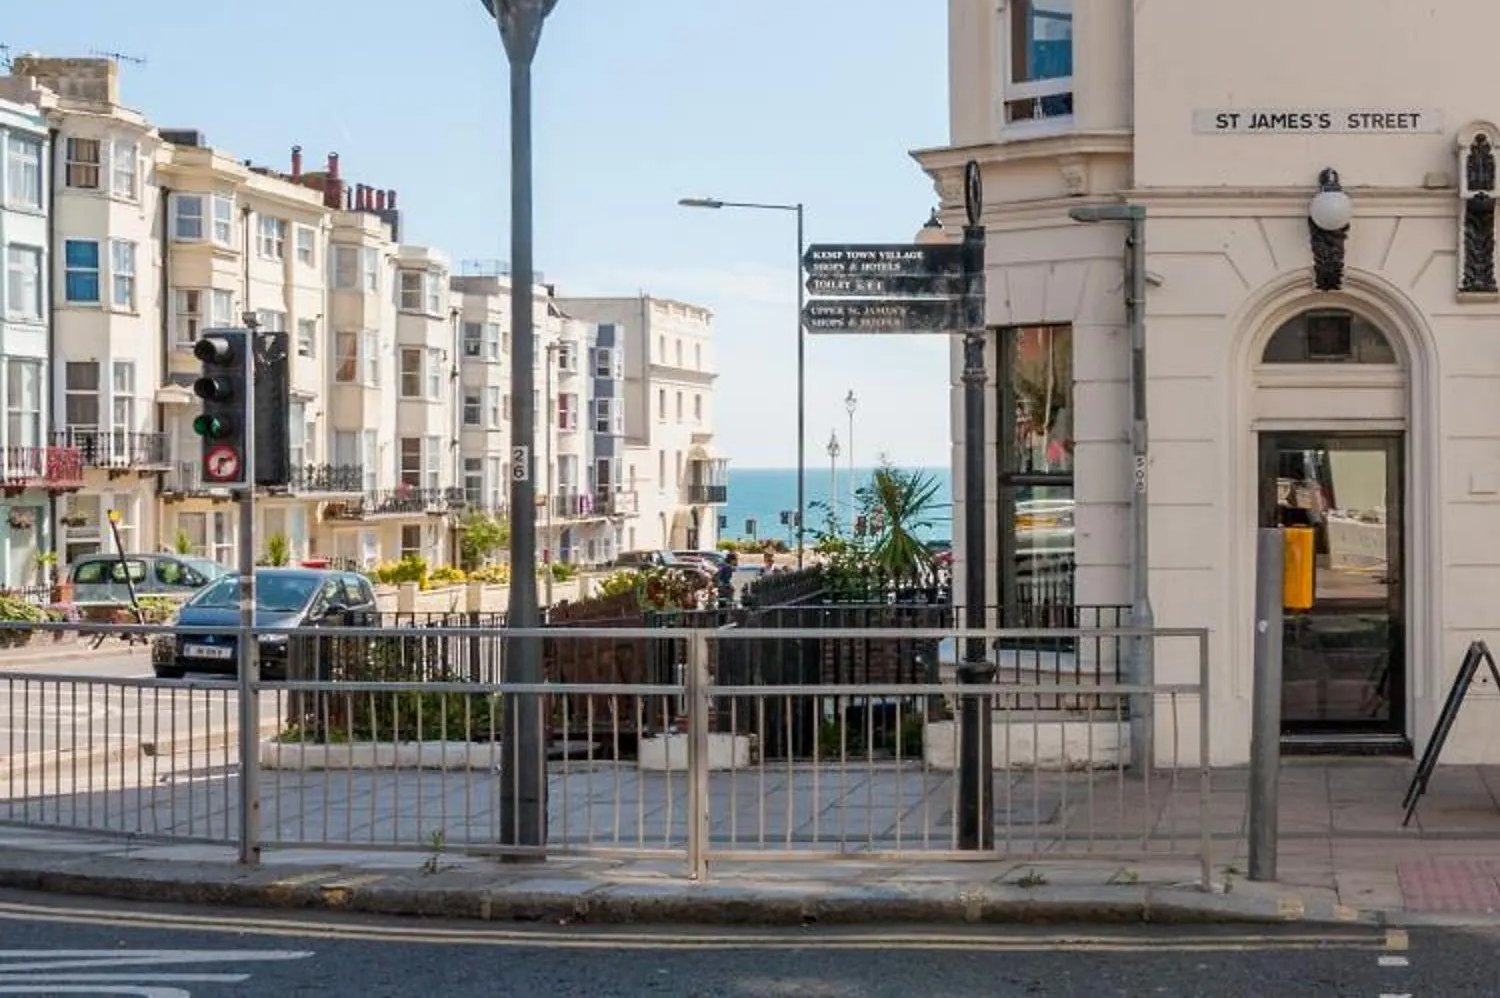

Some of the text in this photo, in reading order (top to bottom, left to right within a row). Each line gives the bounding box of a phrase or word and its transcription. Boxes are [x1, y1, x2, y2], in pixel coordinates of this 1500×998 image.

[1215, 113, 1421, 129] ST JAMES'S STREET
[846, 251, 876, 259] TOWN
[879, 251, 924, 259] VILLAGE
[861, 262, 901, 271] HOTELS
[513, 449, 525, 479] 26
